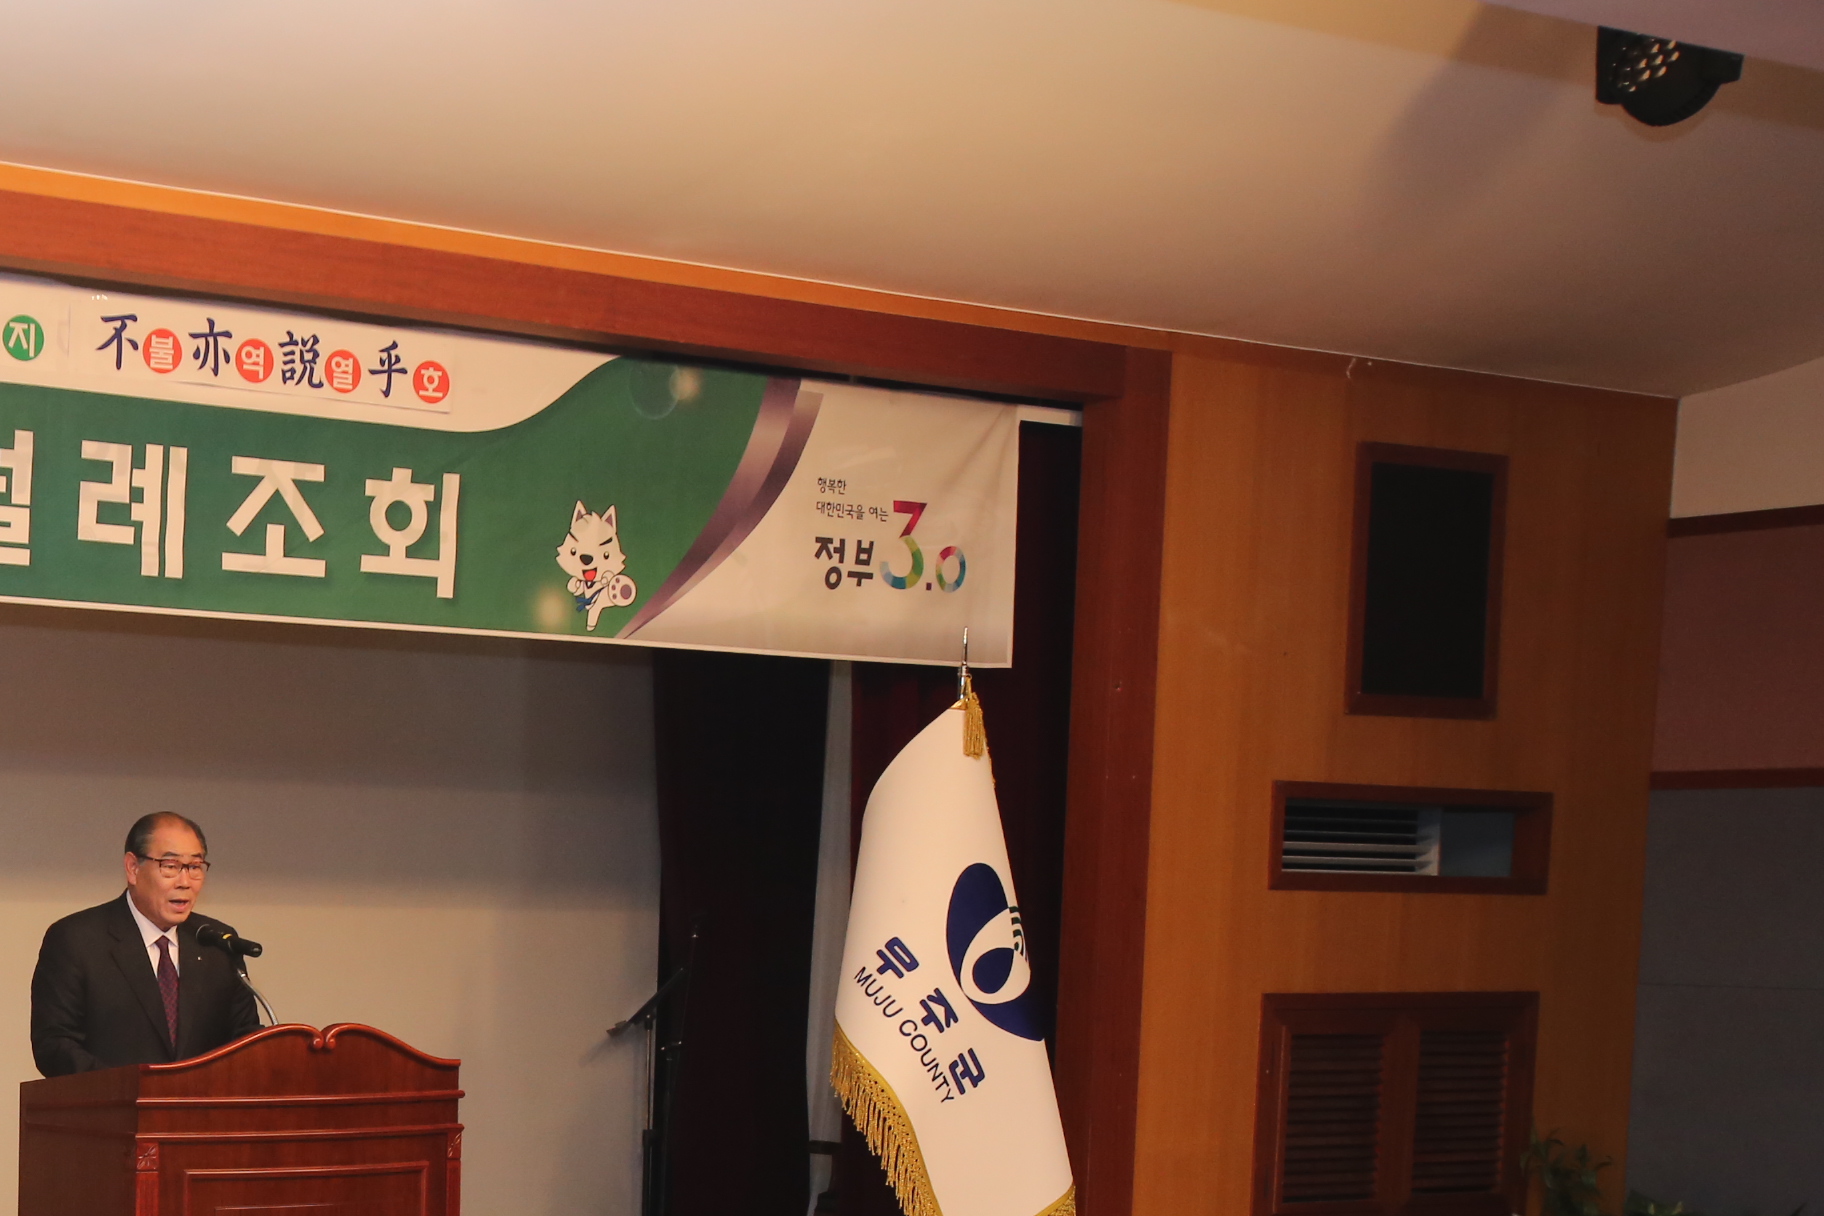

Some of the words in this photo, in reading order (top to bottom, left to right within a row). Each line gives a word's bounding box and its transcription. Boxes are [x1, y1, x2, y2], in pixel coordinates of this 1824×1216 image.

[815, 501, 865, 520] 대한민국을
[869, 506, 889, 522] 여는
[817, 477, 847, 495] 행복한
[814, 536, 875, 590] 정부
[879, 499, 967, 593] 3.0
[853, 966, 904, 1018] MUJU
[898, 1018, 955, 1103] COUNTY
[876, 936, 985, 1095] 무주군
